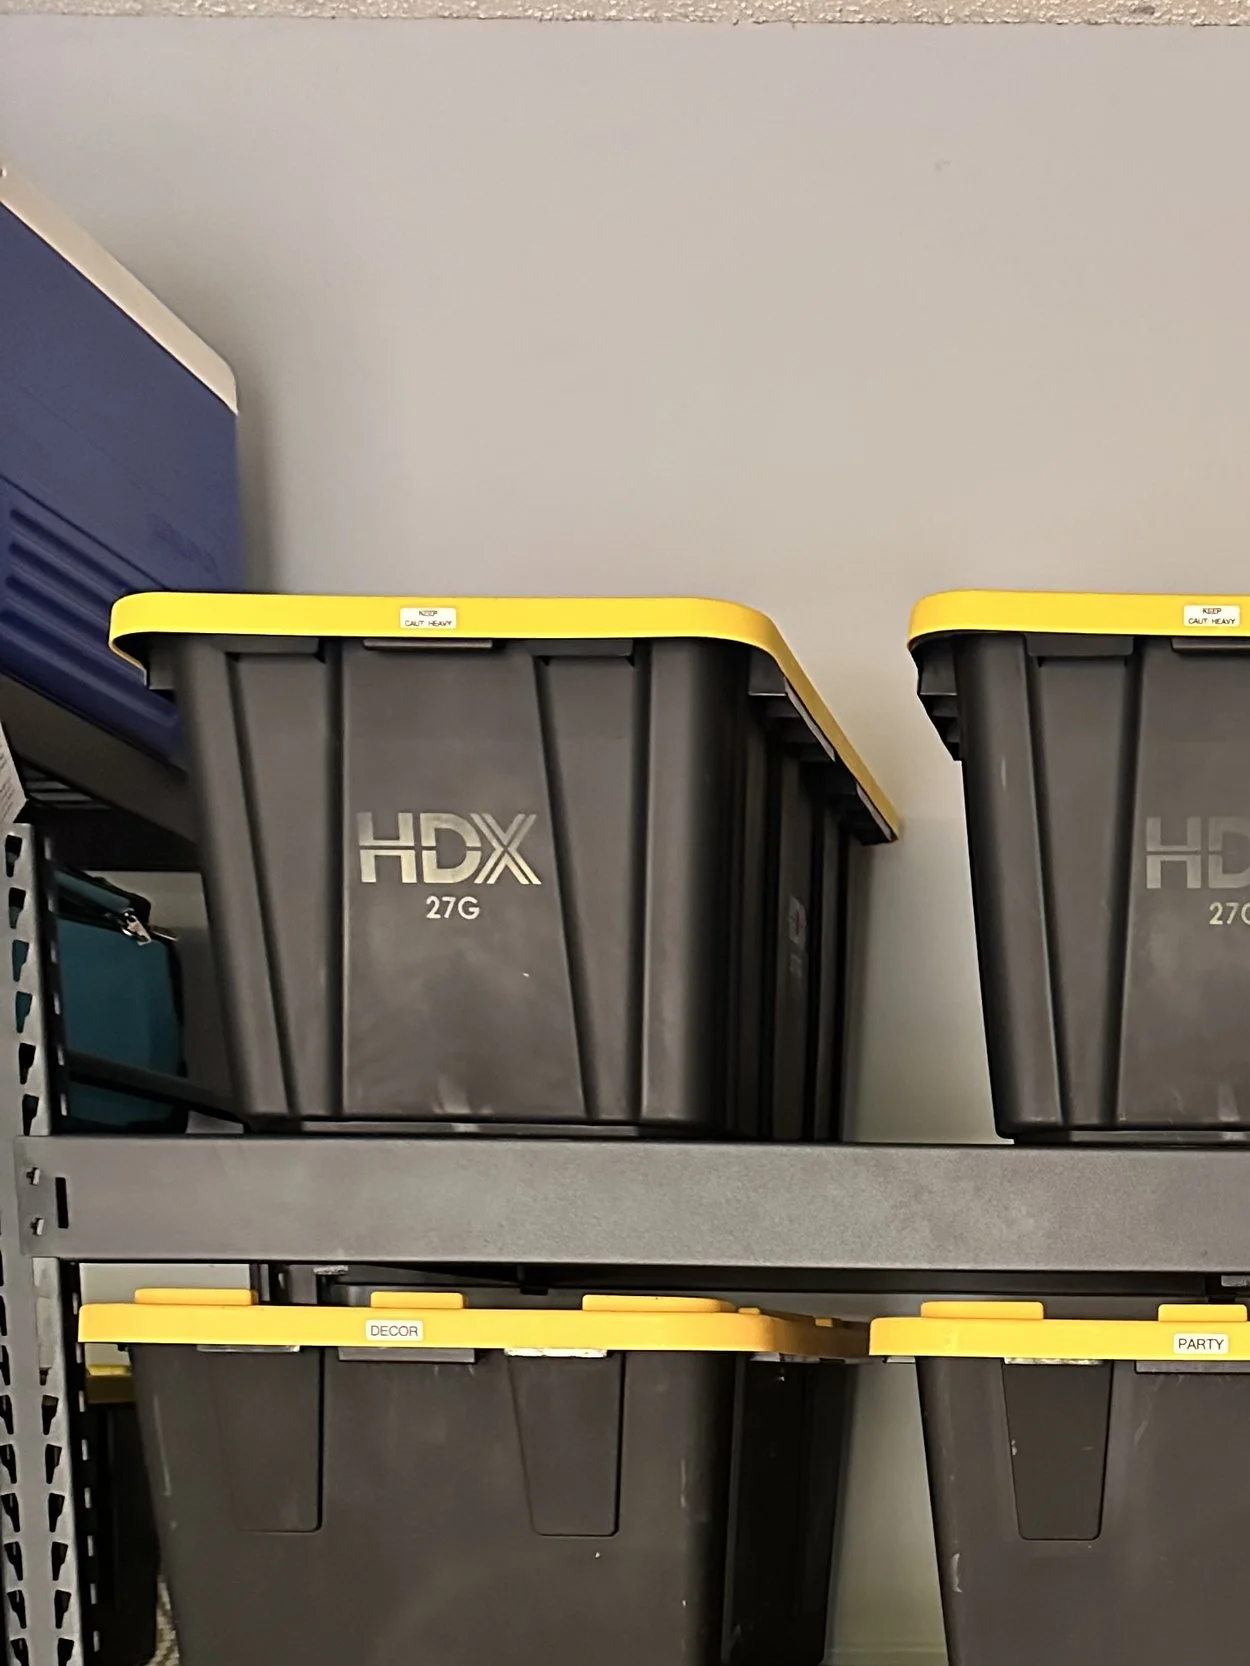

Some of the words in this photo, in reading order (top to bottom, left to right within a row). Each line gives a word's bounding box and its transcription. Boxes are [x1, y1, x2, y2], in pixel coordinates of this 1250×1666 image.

[356, 811, 542, 887] HDX
[425, 896, 481, 920] 27G
[370, 1325, 419, 1337] DECOR
[1178, 1338, 1224, 1350] PARTY
